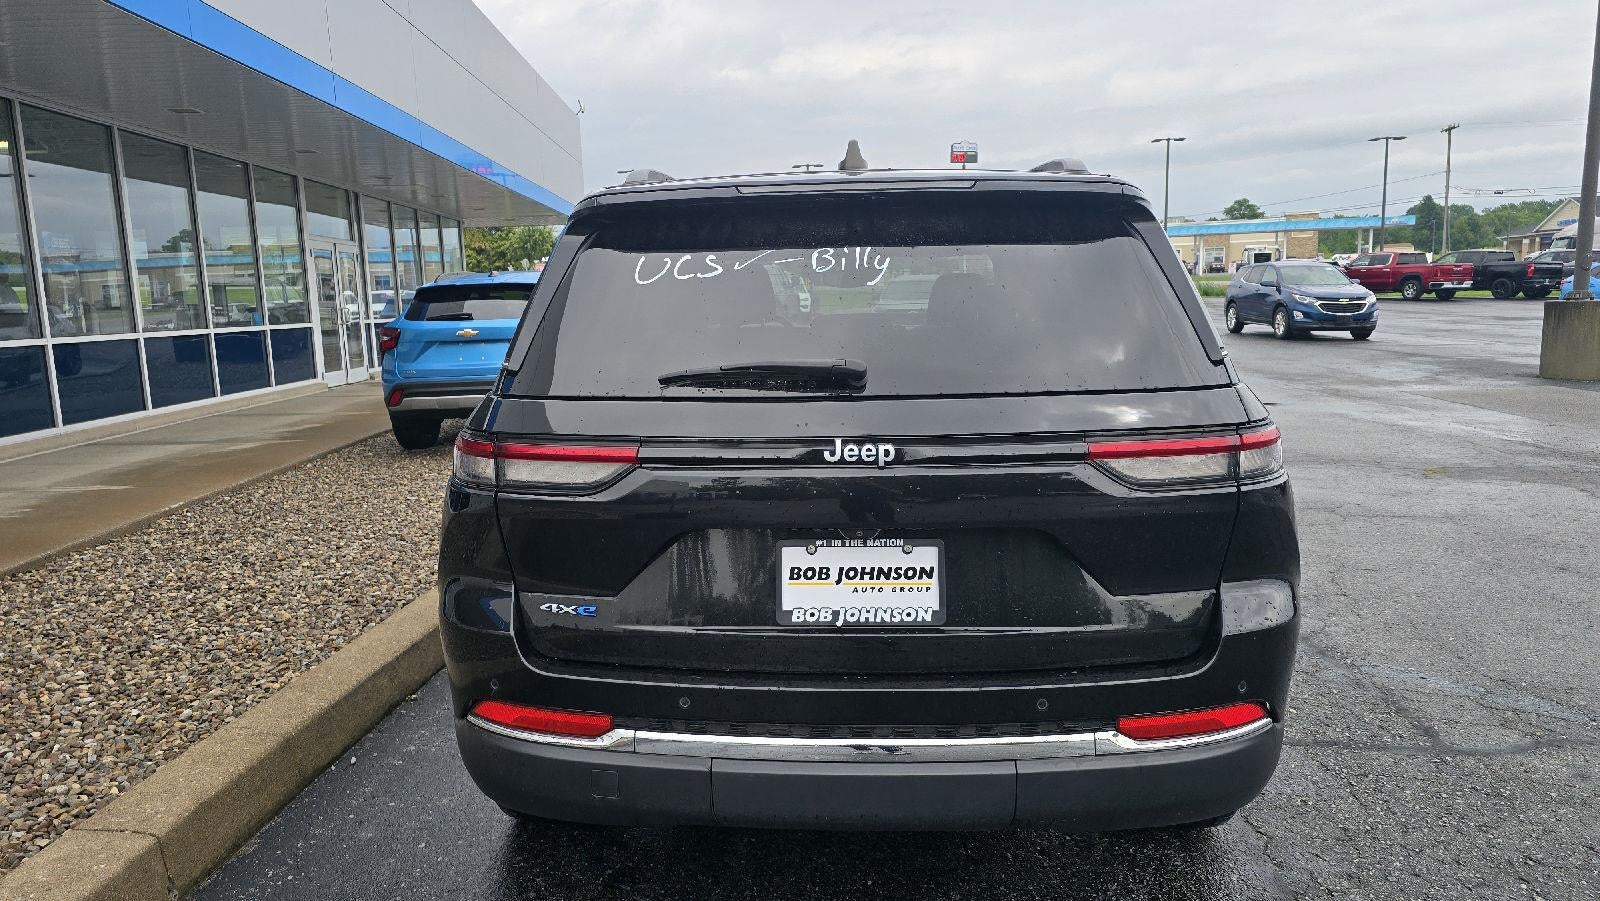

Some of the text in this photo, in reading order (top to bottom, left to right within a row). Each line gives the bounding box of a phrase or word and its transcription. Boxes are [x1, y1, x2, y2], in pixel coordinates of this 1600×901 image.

[811, 246, 891, 286] Billy
[823, 437, 896, 467] Jeep
[815, 538, 904, 547] #1 IN THE NATION
[788, 566, 935, 586] BOB JOHNSON
[851, 586, 932, 594] AUTO GROUP
[791, 607, 933, 627] BOB JOHNSON
